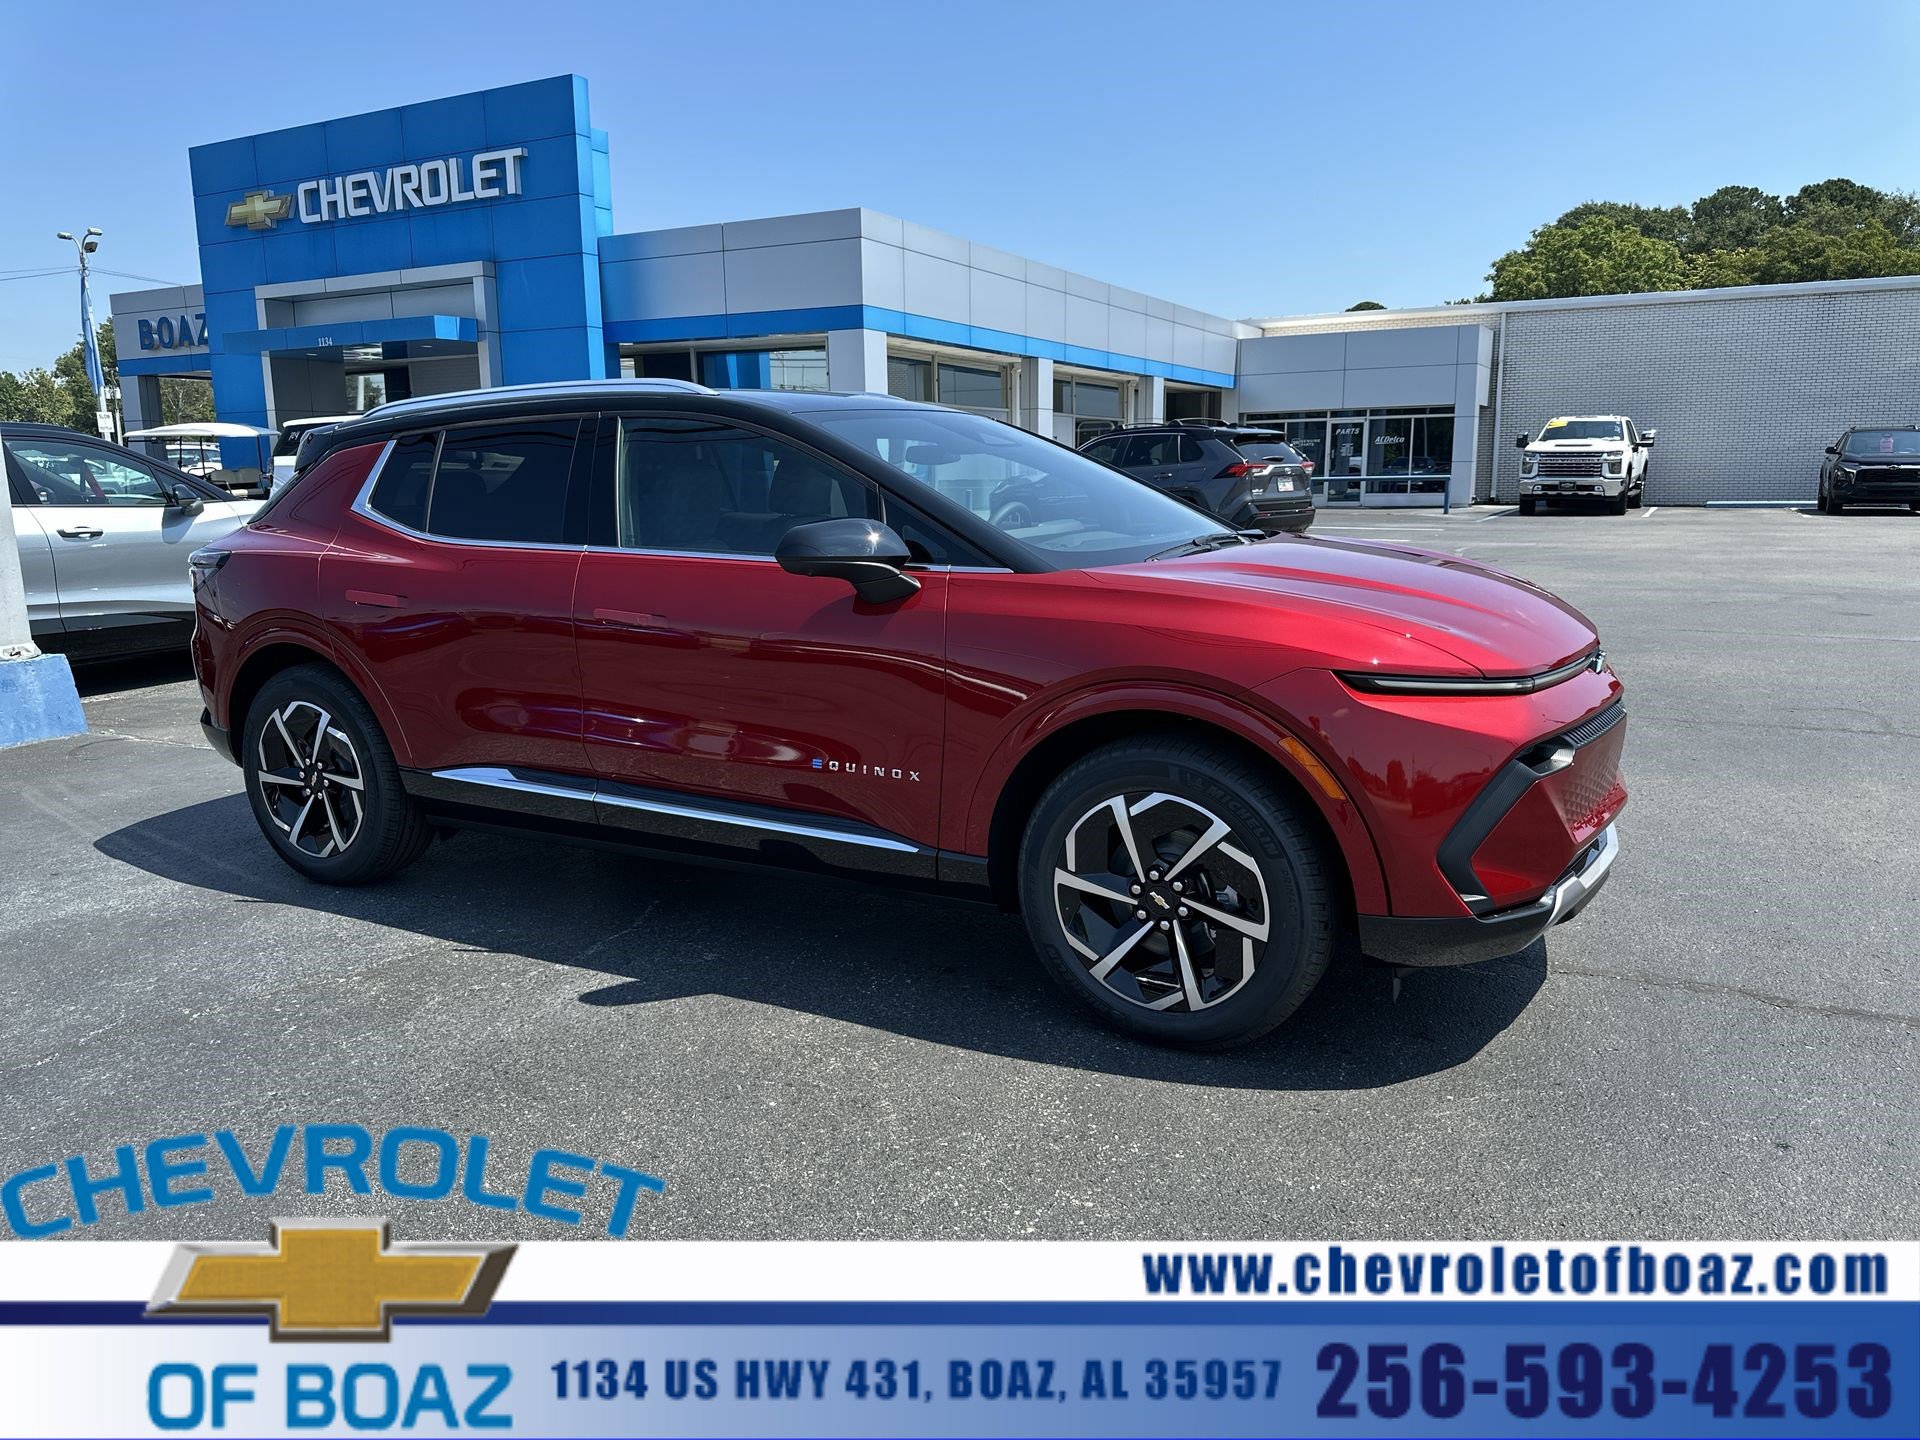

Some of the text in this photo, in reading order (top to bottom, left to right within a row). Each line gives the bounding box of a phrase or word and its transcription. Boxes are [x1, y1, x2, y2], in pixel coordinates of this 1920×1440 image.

[297, 148, 527, 224] CHEVROLET
[138, 313, 209, 350] BOAZ
[318, 337, 333, 347] 1134
[1336, 428, 1361, 436] PARTS
[1375, 435, 1405, 445] ACDelco
[812, 758, 920, 782] EQUINOX
